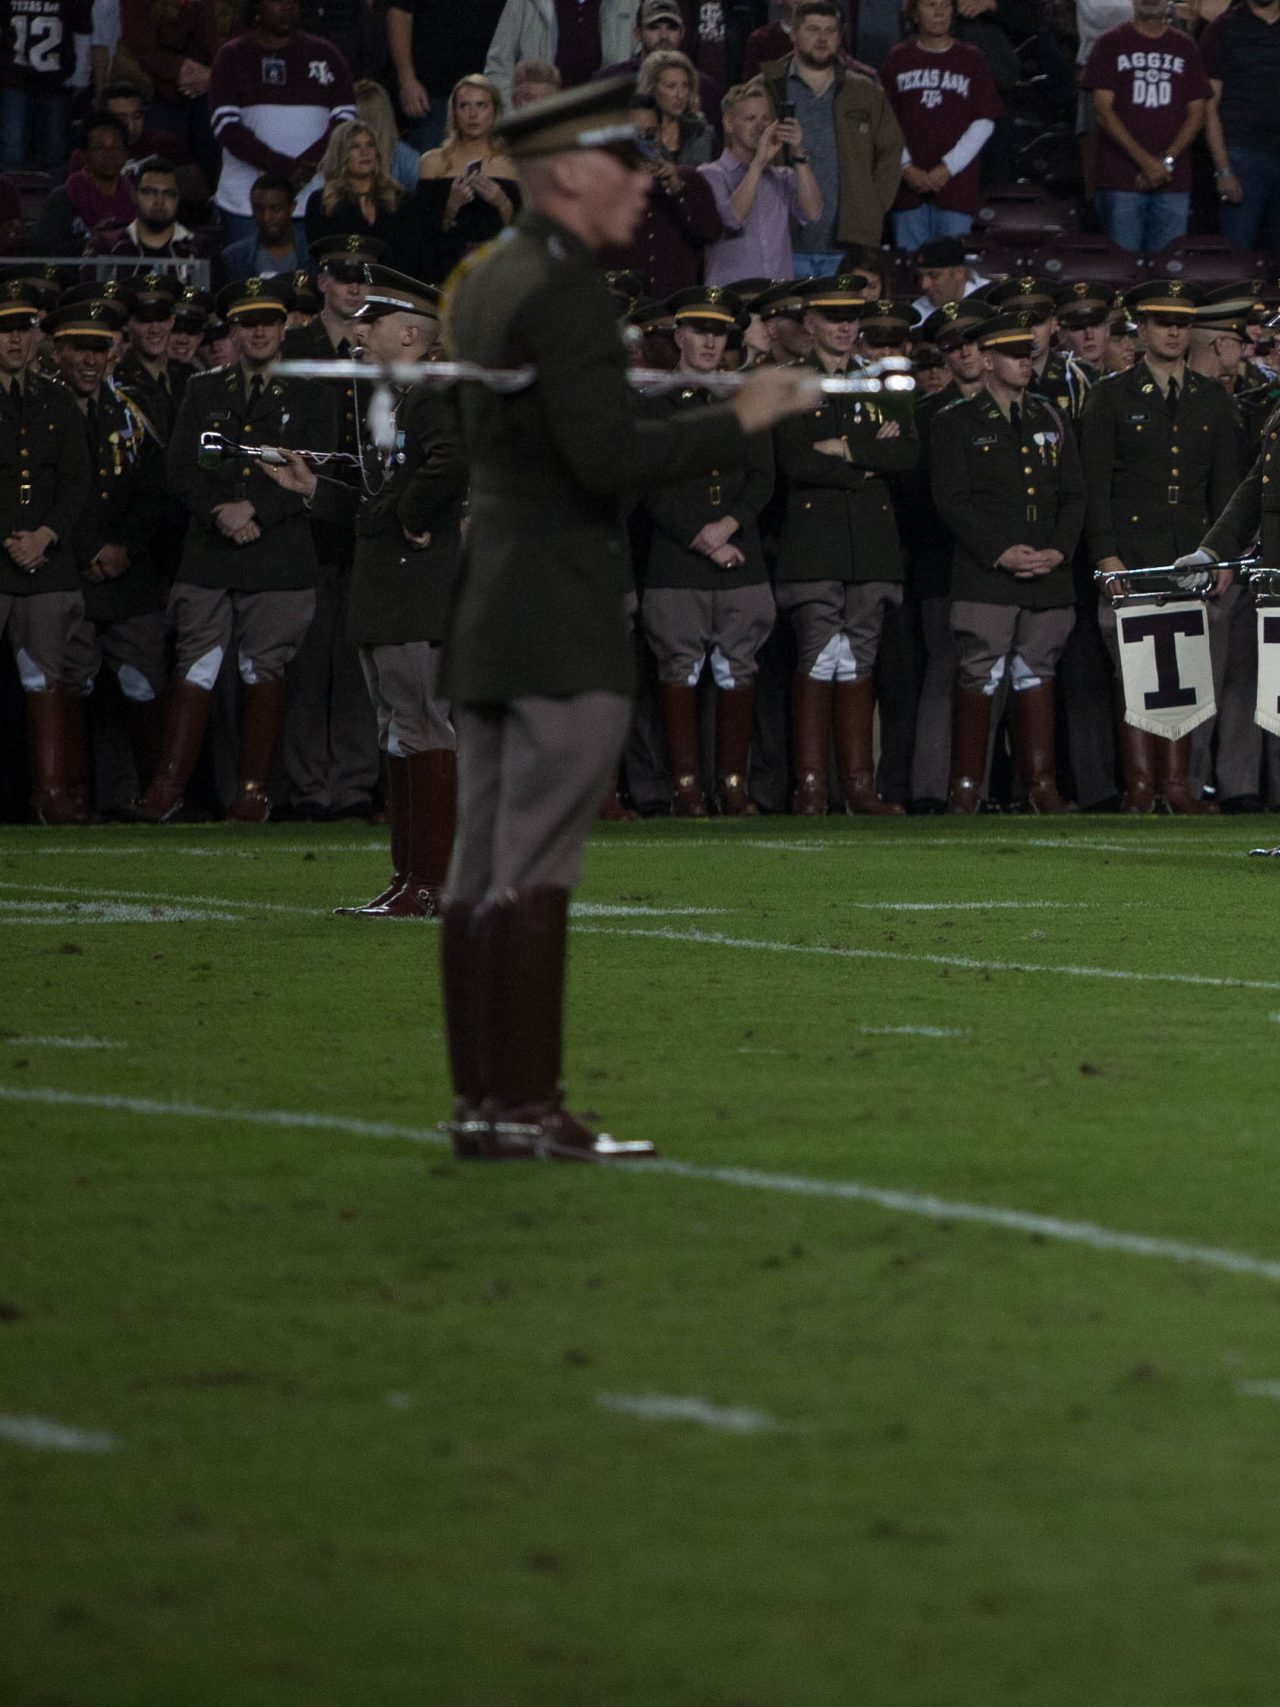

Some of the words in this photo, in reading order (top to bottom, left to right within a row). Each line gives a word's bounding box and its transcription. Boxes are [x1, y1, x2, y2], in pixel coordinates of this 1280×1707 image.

[10, 15, 63, 71] 12
[1117, 52, 1185, 74] AGGIE
[896, 68, 941, 93] TEXAS
[941, 69, 971, 98] A&M
[1132, 79, 1173, 108] DAD
[1121, 609, 1205, 710] T
